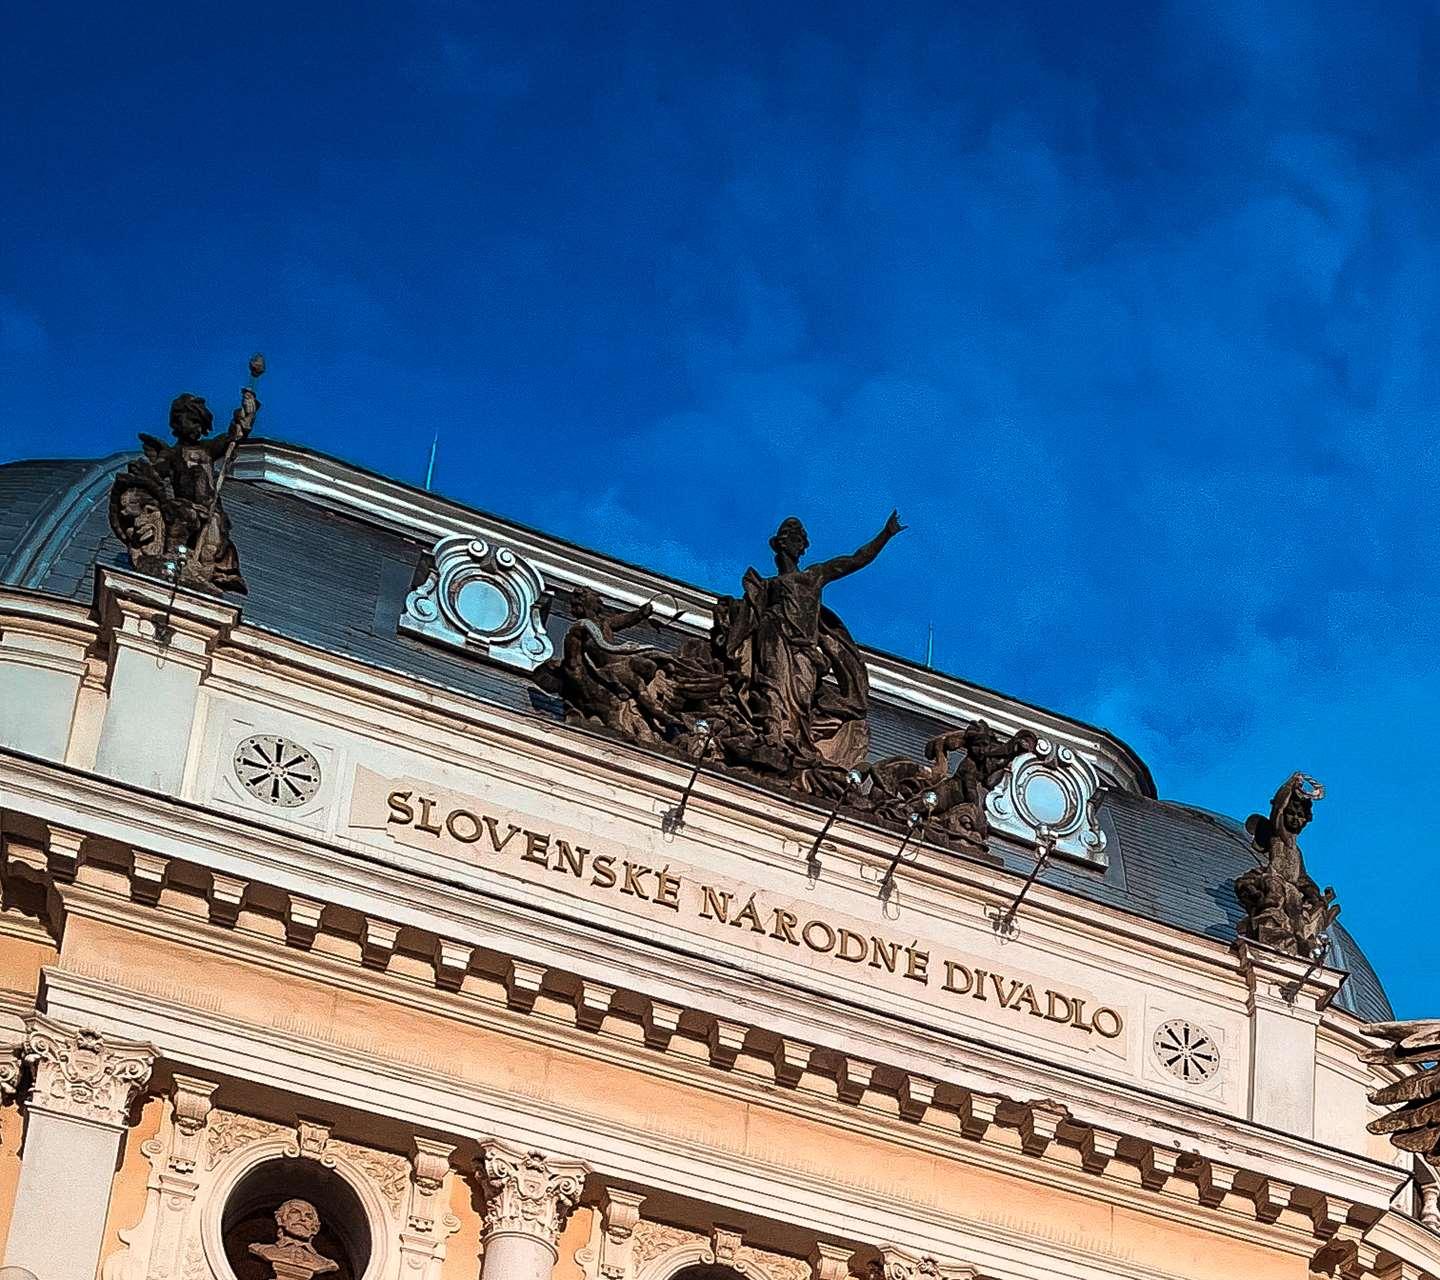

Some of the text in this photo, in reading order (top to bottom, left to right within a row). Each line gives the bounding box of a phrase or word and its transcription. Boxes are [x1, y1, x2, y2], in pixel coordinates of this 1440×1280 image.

[386, 790, 1124, 1040] SLOVENSKÉ NÁRODNÉ DIVADLO
